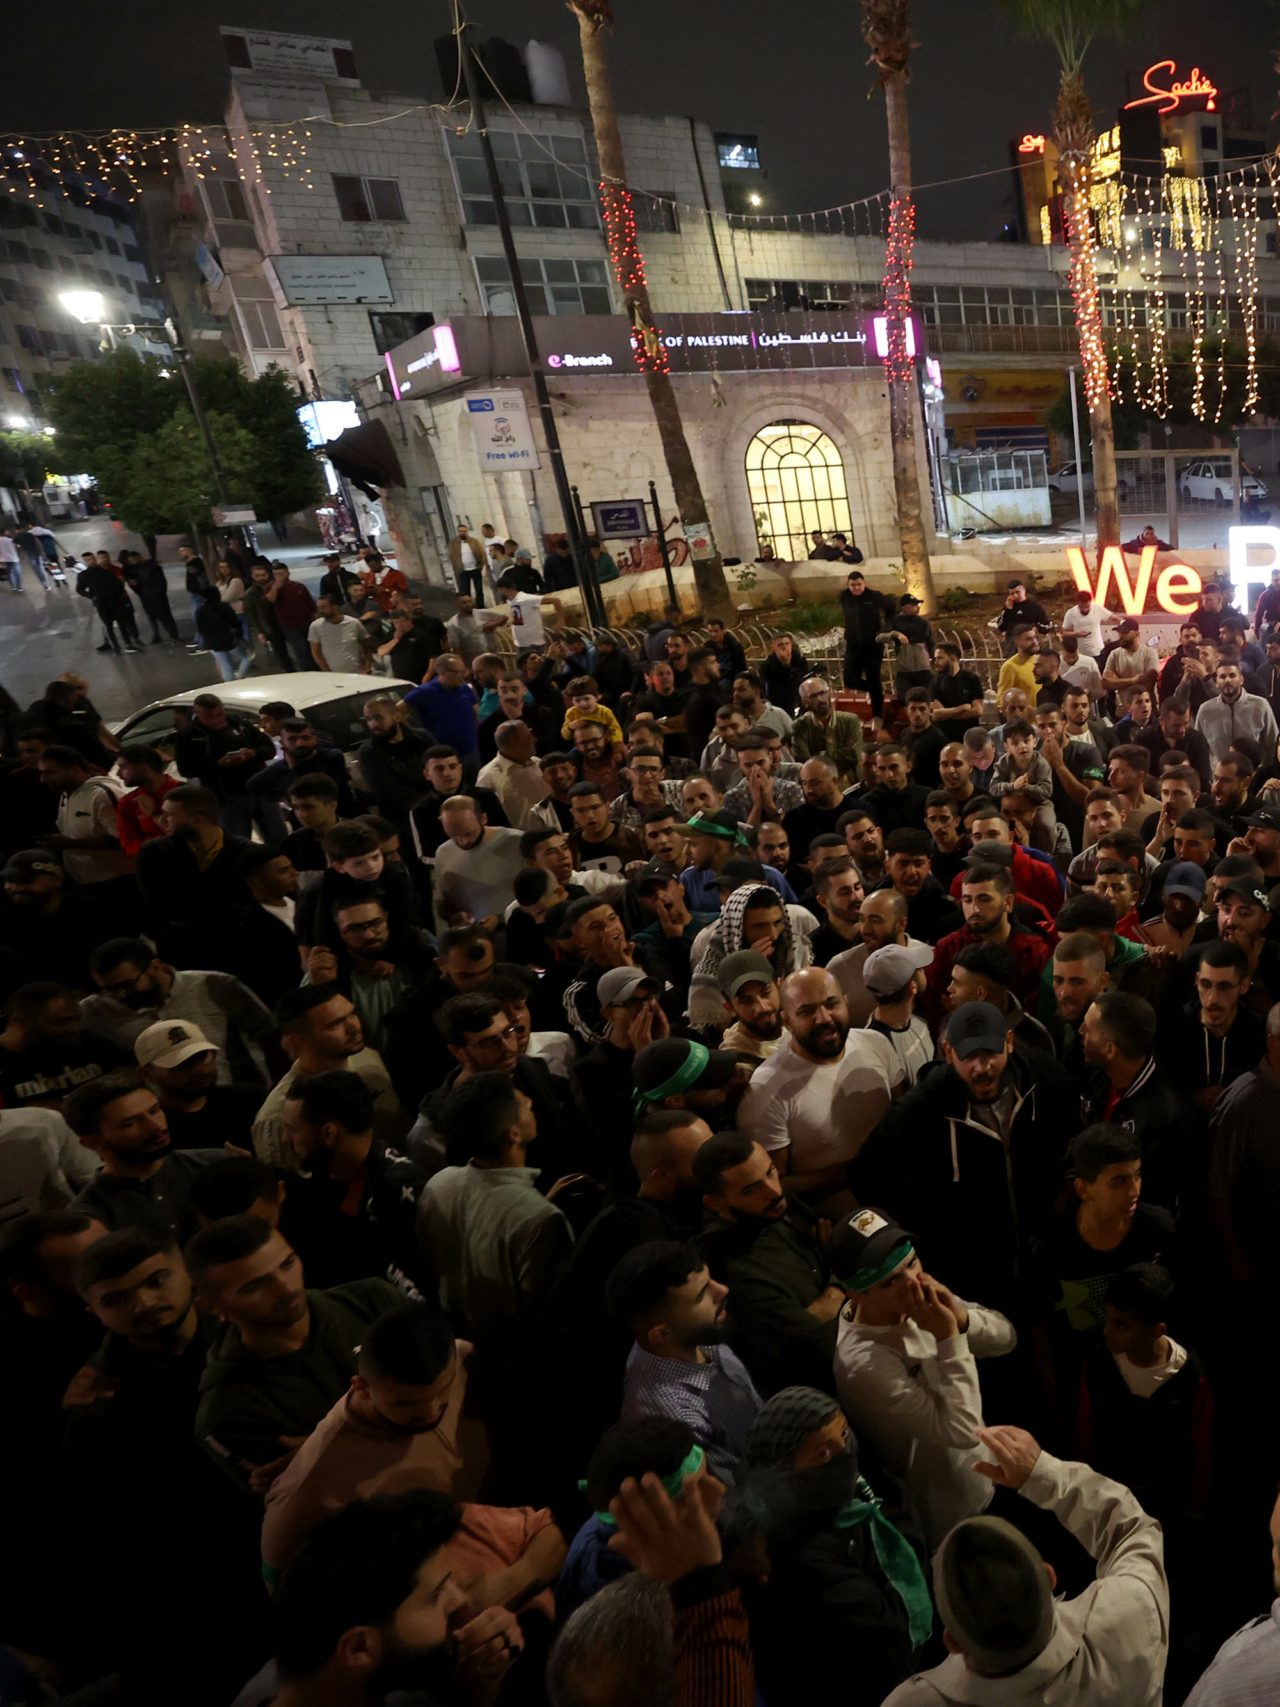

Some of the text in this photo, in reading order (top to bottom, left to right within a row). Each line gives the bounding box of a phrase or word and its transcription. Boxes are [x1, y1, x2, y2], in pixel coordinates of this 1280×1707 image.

[666, 336, 683, 347] OF
[688, 334, 749, 347] PALESTINE
[758, 331, 867, 347] بنك فلسطين
[547, 353, 613, 368] e-Branch
[486, 451, 506, 460] Free
[1066, 543, 1203, 616] We
